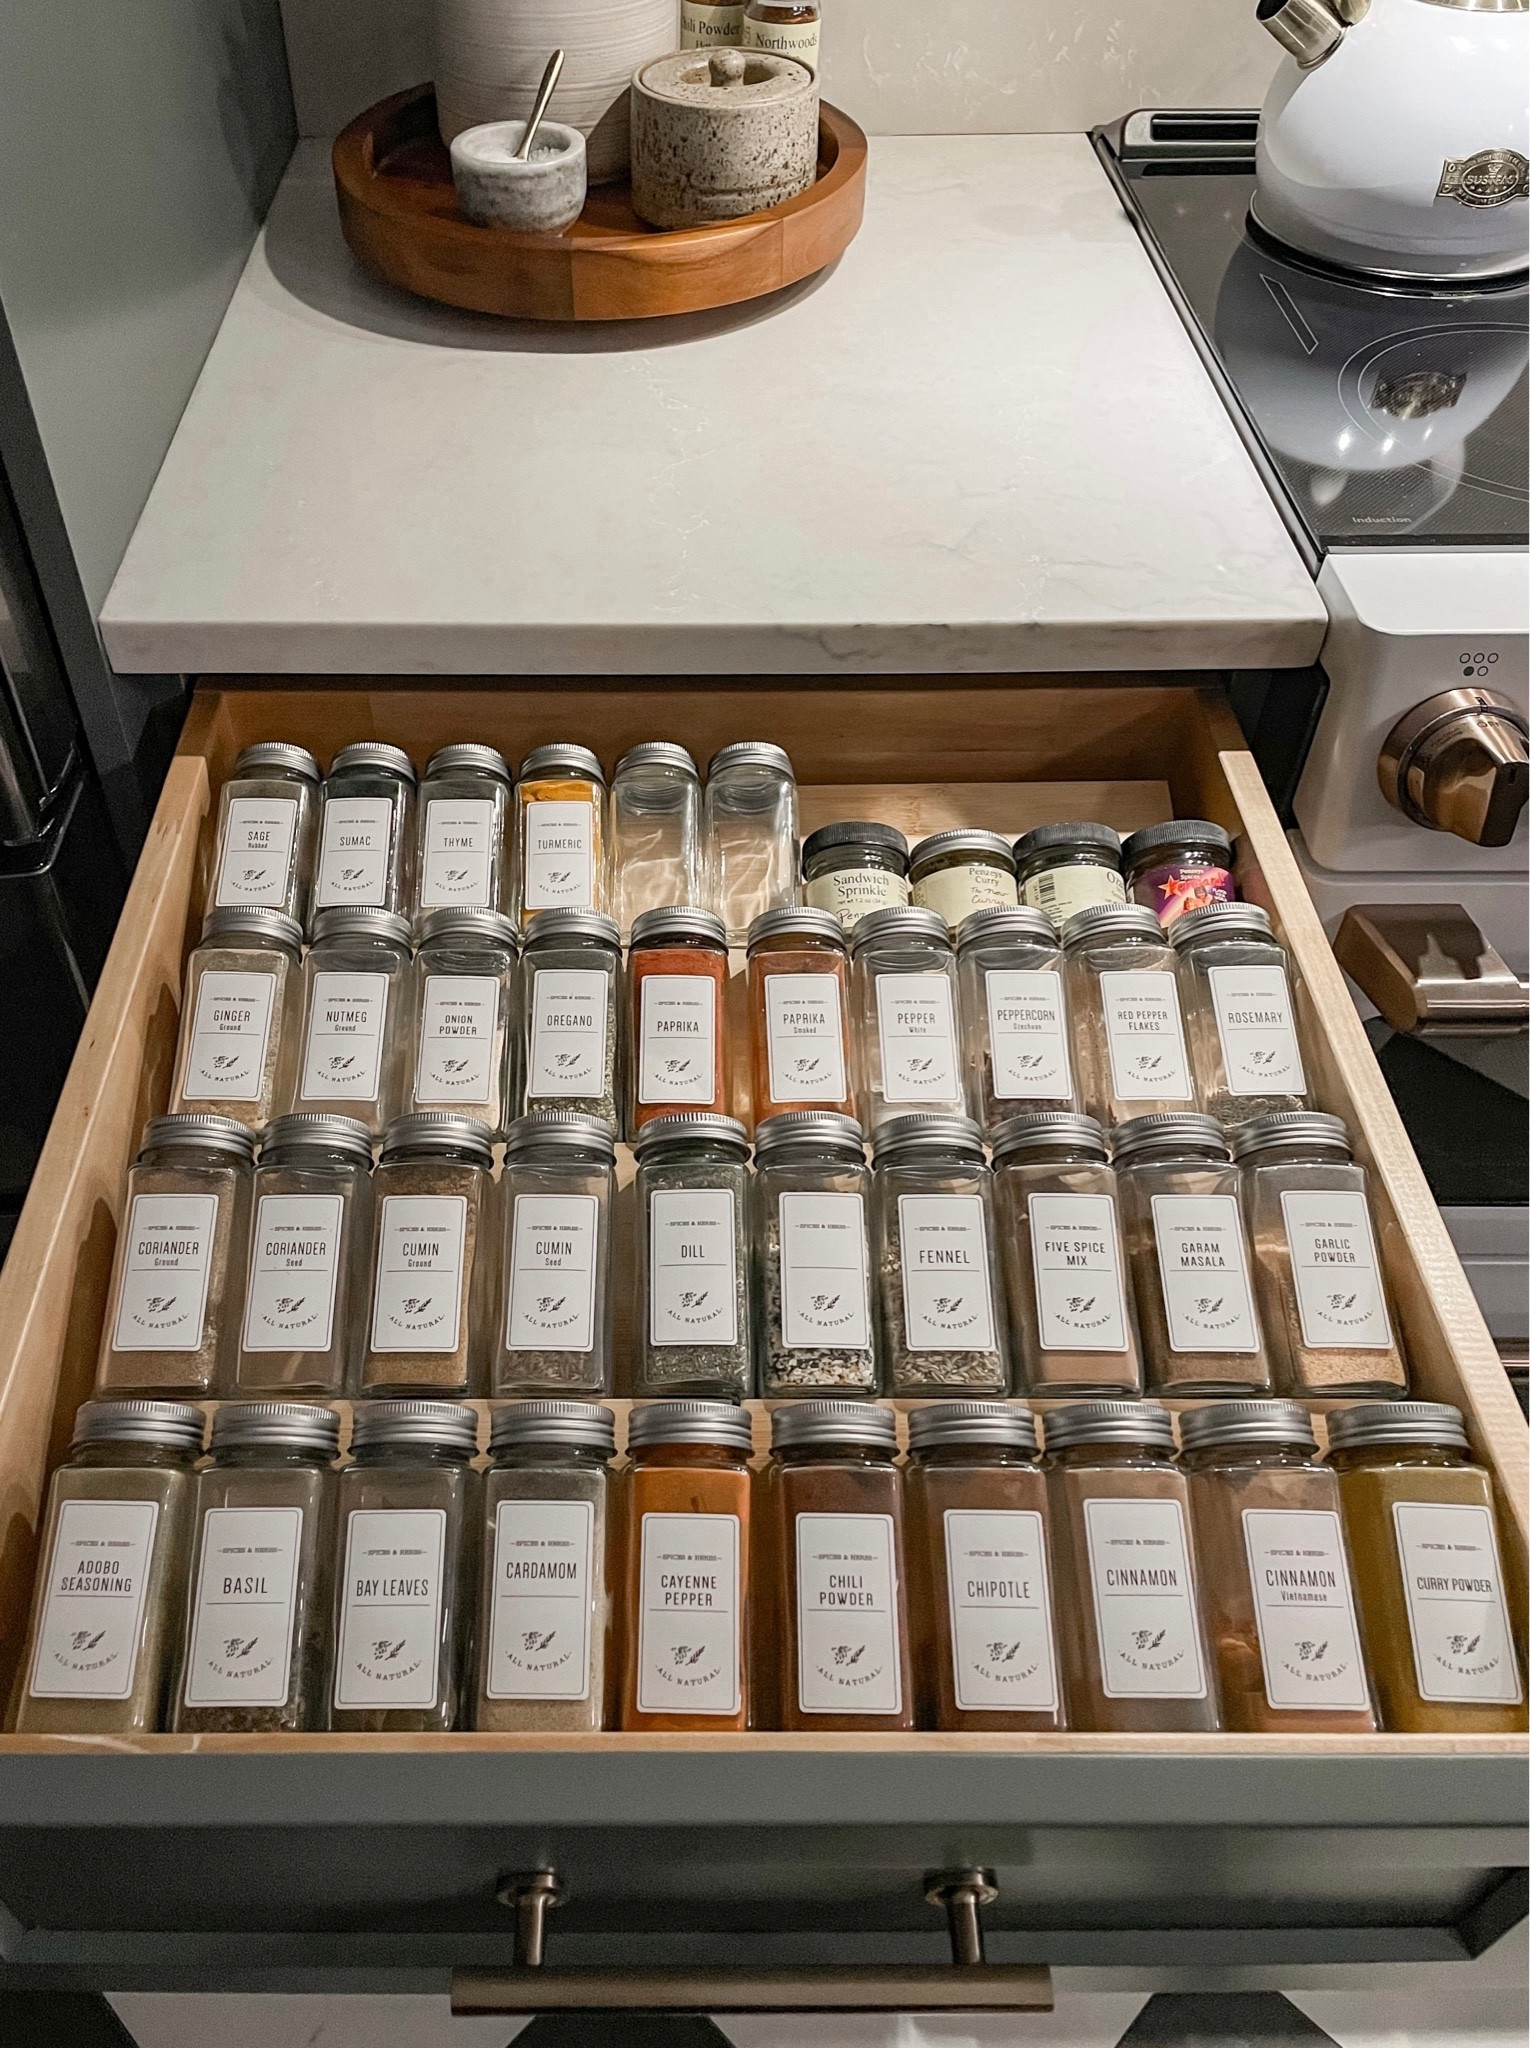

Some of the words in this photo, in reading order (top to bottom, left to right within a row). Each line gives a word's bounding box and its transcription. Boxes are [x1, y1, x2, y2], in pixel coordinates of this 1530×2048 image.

[682, 17, 695, 32] hili
[699, 22, 740, 36] Powder
[756, 32, 816, 49] Northwoods
[248, 831, 270, 841] SAGE
[340, 836, 370, 846] SUMAC
[444, 838, 472, 847] THYME
[538, 839, 581, 849] TURMERIC
[833, 873, 889, 886] Sandwich
[969, 868, 1002, 878] Penzeys
[975, 876, 999, 886] Curry
[838, 885, 887, 897] Sprinkle
[214, 1010, 250, 1021] GINGER
[326, 1011, 367, 1022] NUTMEG
[445, 1015, 472, 1023] ONION
[547, 1015, 592, 1026] OREGANO
[783, 1013, 825, 1024] PAPRIKA
[898, 1013, 935, 1024] PEPPER
[997, 1010, 1055, 1021] PEPPERCORN
[1118, 1011, 1133, 1019] RED
[1137, 1011, 1167, 1019] PEPPER
[1228, 1012, 1282, 1023] ROSEMARY
[439, 1026, 476, 1035] POWDER
[657, 1021, 698, 1032] PAPRIKA
[1129, 1022, 1159, 1030] FLAKES
[201, 1070, 211, 1079] ALL
[215, 1071, 249, 1082] NATURAL
[317, 1071, 328, 1079] ALL
[332, 1072, 365, 1082] NATURAL
[430, 1072, 442, 1082] ALL
[446, 1075, 479, 1085] NATURAL
[544, 1068, 555, 1077] ALL
[559, 1068, 592, 1079] NATURAL
[655, 1074, 666, 1083] ALL
[669, 1073, 702, 1085] NATURAL
[138, 1241, 199, 1255] CORIANDER
[266, 1242, 326, 1255] CORIANDER
[403, 1243, 439, 1256] CUMIN
[536, 1242, 571, 1255] CUMIN
[1045, 1242, 1069, 1252] FIVE
[1074, 1242, 1105, 1253] SPICE
[1182, 1243, 1219, 1253] GARAM
[1315, 1239, 1350, 1249] GARLIC
[682, 1245, 704, 1258] DILL
[920, 1250, 970, 1263] FENNEL
[1314, 1252, 1355, 1262] POWDER
[154, 1258, 178, 1266] Ground
[286, 1258, 302, 1266] Seed
[408, 1259, 431, 1267] Ground
[545, 1258, 561, 1266] Seed
[1067, 1256, 1087, 1265] MIX
[1181, 1256, 1225, 1266] MASALA
[133, 1315, 145, 1325] ALL
[149, 1315, 187, 1328] NATURAL
[263, 1316, 274, 1326] ALL
[278, 1315, 317, 1329] NATURAL
[389, 1316, 402, 1327] ALL
[406, 1315, 444, 1330] NATURAL
[524, 1314, 537, 1325] ALL
[541, 1314, 579, 1328] NATURAL
[668, 1310, 681, 1320] ALL
[685, 1309, 721, 1323] NATURAL
[800, 1313, 813, 1323] ALL
[817, 1313, 853, 1326] NATURAL
[922, 1316, 936, 1326] ALL
[941, 1316, 977, 1329] NATURAL
[1056, 1315, 1070, 1325] ALL
[1074, 1315, 1110, 1328] NATURAL
[1185, 1316, 1199, 1326] ALL
[1203, 1314, 1240, 1329] NATURAL
[1317, 1312, 1332, 1322] ALL
[1337, 1312, 1372, 1325] NATURAL
[77, 1561, 119, 1574] ADOBO
[507, 1562, 576, 1579] CARDAMOM
[661, 1575, 716, 1589] CAYENNE
[830, 1575, 862, 1588] CHILI
[1107, 1569, 1177, 1586] CINNAMON
[1266, 1570, 1335, 1587] CINNAMON
[61, 1577, 131, 1592] SEASONING
[223, 1577, 267, 1594] BASIL
[357, 1580, 379, 1596] BAY
[383, 1579, 428, 1596] LEAVES
[967, 1581, 1030, 1598] CHIPOTLE
[1417, 1577, 1448, 1590] CURRY
[1452, 1578, 1492, 1592] POWDER
[665, 1592, 712, 1606] PEPPER
[820, 1592, 873, 1605] POWDER
[1281, 1591, 1327, 1601] Vietnamese
[54, 1653, 68, 1666] ALL
[71, 1652, 118, 1671] NATURAL
[507, 1654, 522, 1667] ALL
[527, 1654, 569, 1671] NATURAL
[1118, 1650, 1137, 1666] ALL
[1142, 1653, 1183, 1670] NATURAL
[1436, 1656, 1452, 1670] ALL
[1458, 1658, 1499, 1675] NATURAL
[208, 1661, 222, 1674] ALL
[226, 1660, 271, 1678] NATURAL
[357, 1663, 371, 1677] ALL
[376, 1659, 419, 1680] NATURAL
[974, 1664, 989, 1678] ALL
[995, 1665, 1037, 1682] NATURAL
[1282, 1661, 1301, 1677] ALL
[1306, 1664, 1346, 1681] NATURAL
[657, 1668, 672, 1681] ALL
[677, 1669, 720, 1686] NATURAL
[818, 1668, 833, 1681] ALL
[839, 1667, 882, 1686] NATURAL
